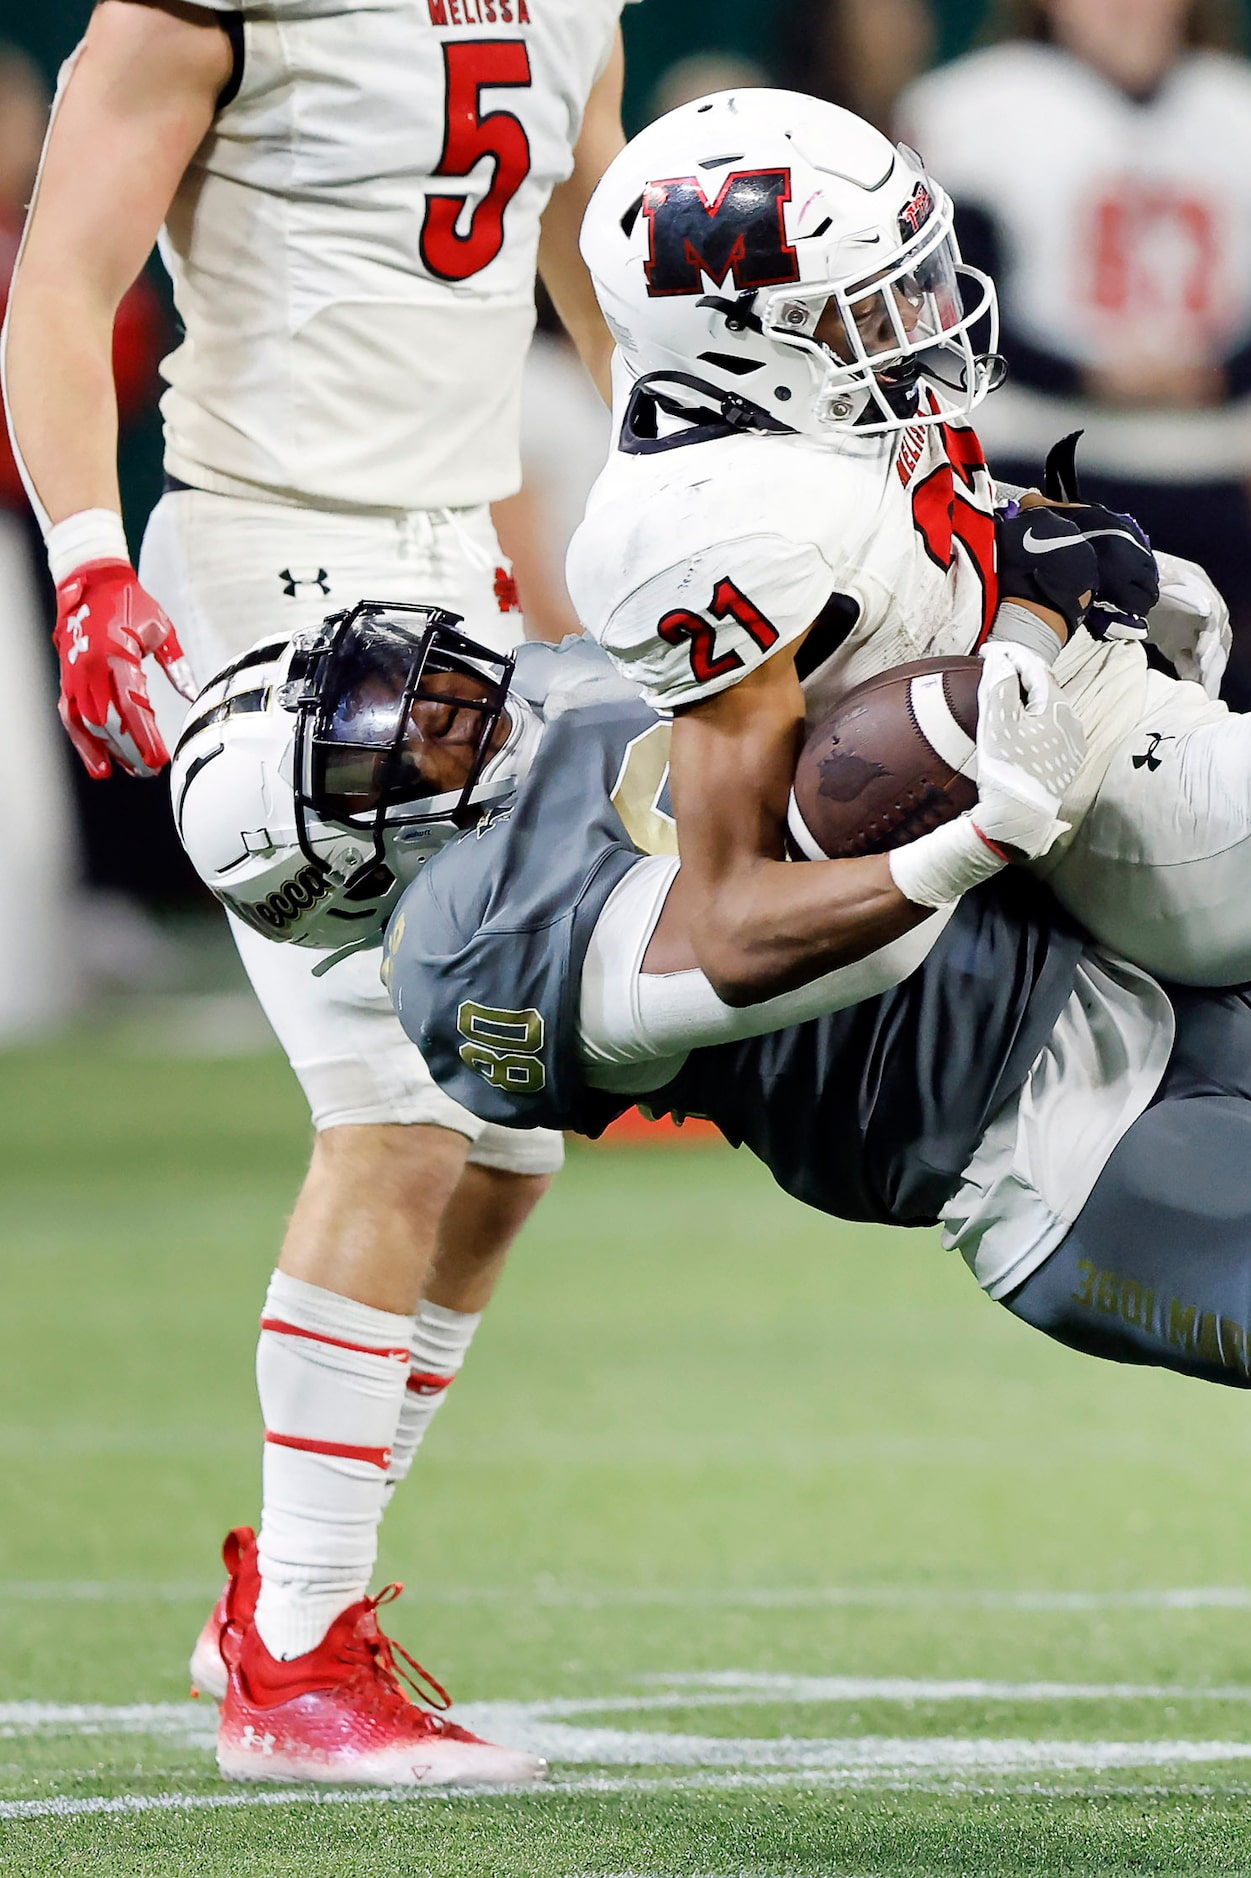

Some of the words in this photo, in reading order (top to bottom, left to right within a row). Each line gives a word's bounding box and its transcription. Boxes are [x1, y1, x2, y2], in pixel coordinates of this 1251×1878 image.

[428, 0, 531, 26] MELISSA
[419, 38, 532, 282] 5
[643, 167, 800, 298] M
[656, 575, 780, 684] 21
[457, 999, 546, 1093] 80
[1072, 1259, 1157, 1333] 3601
